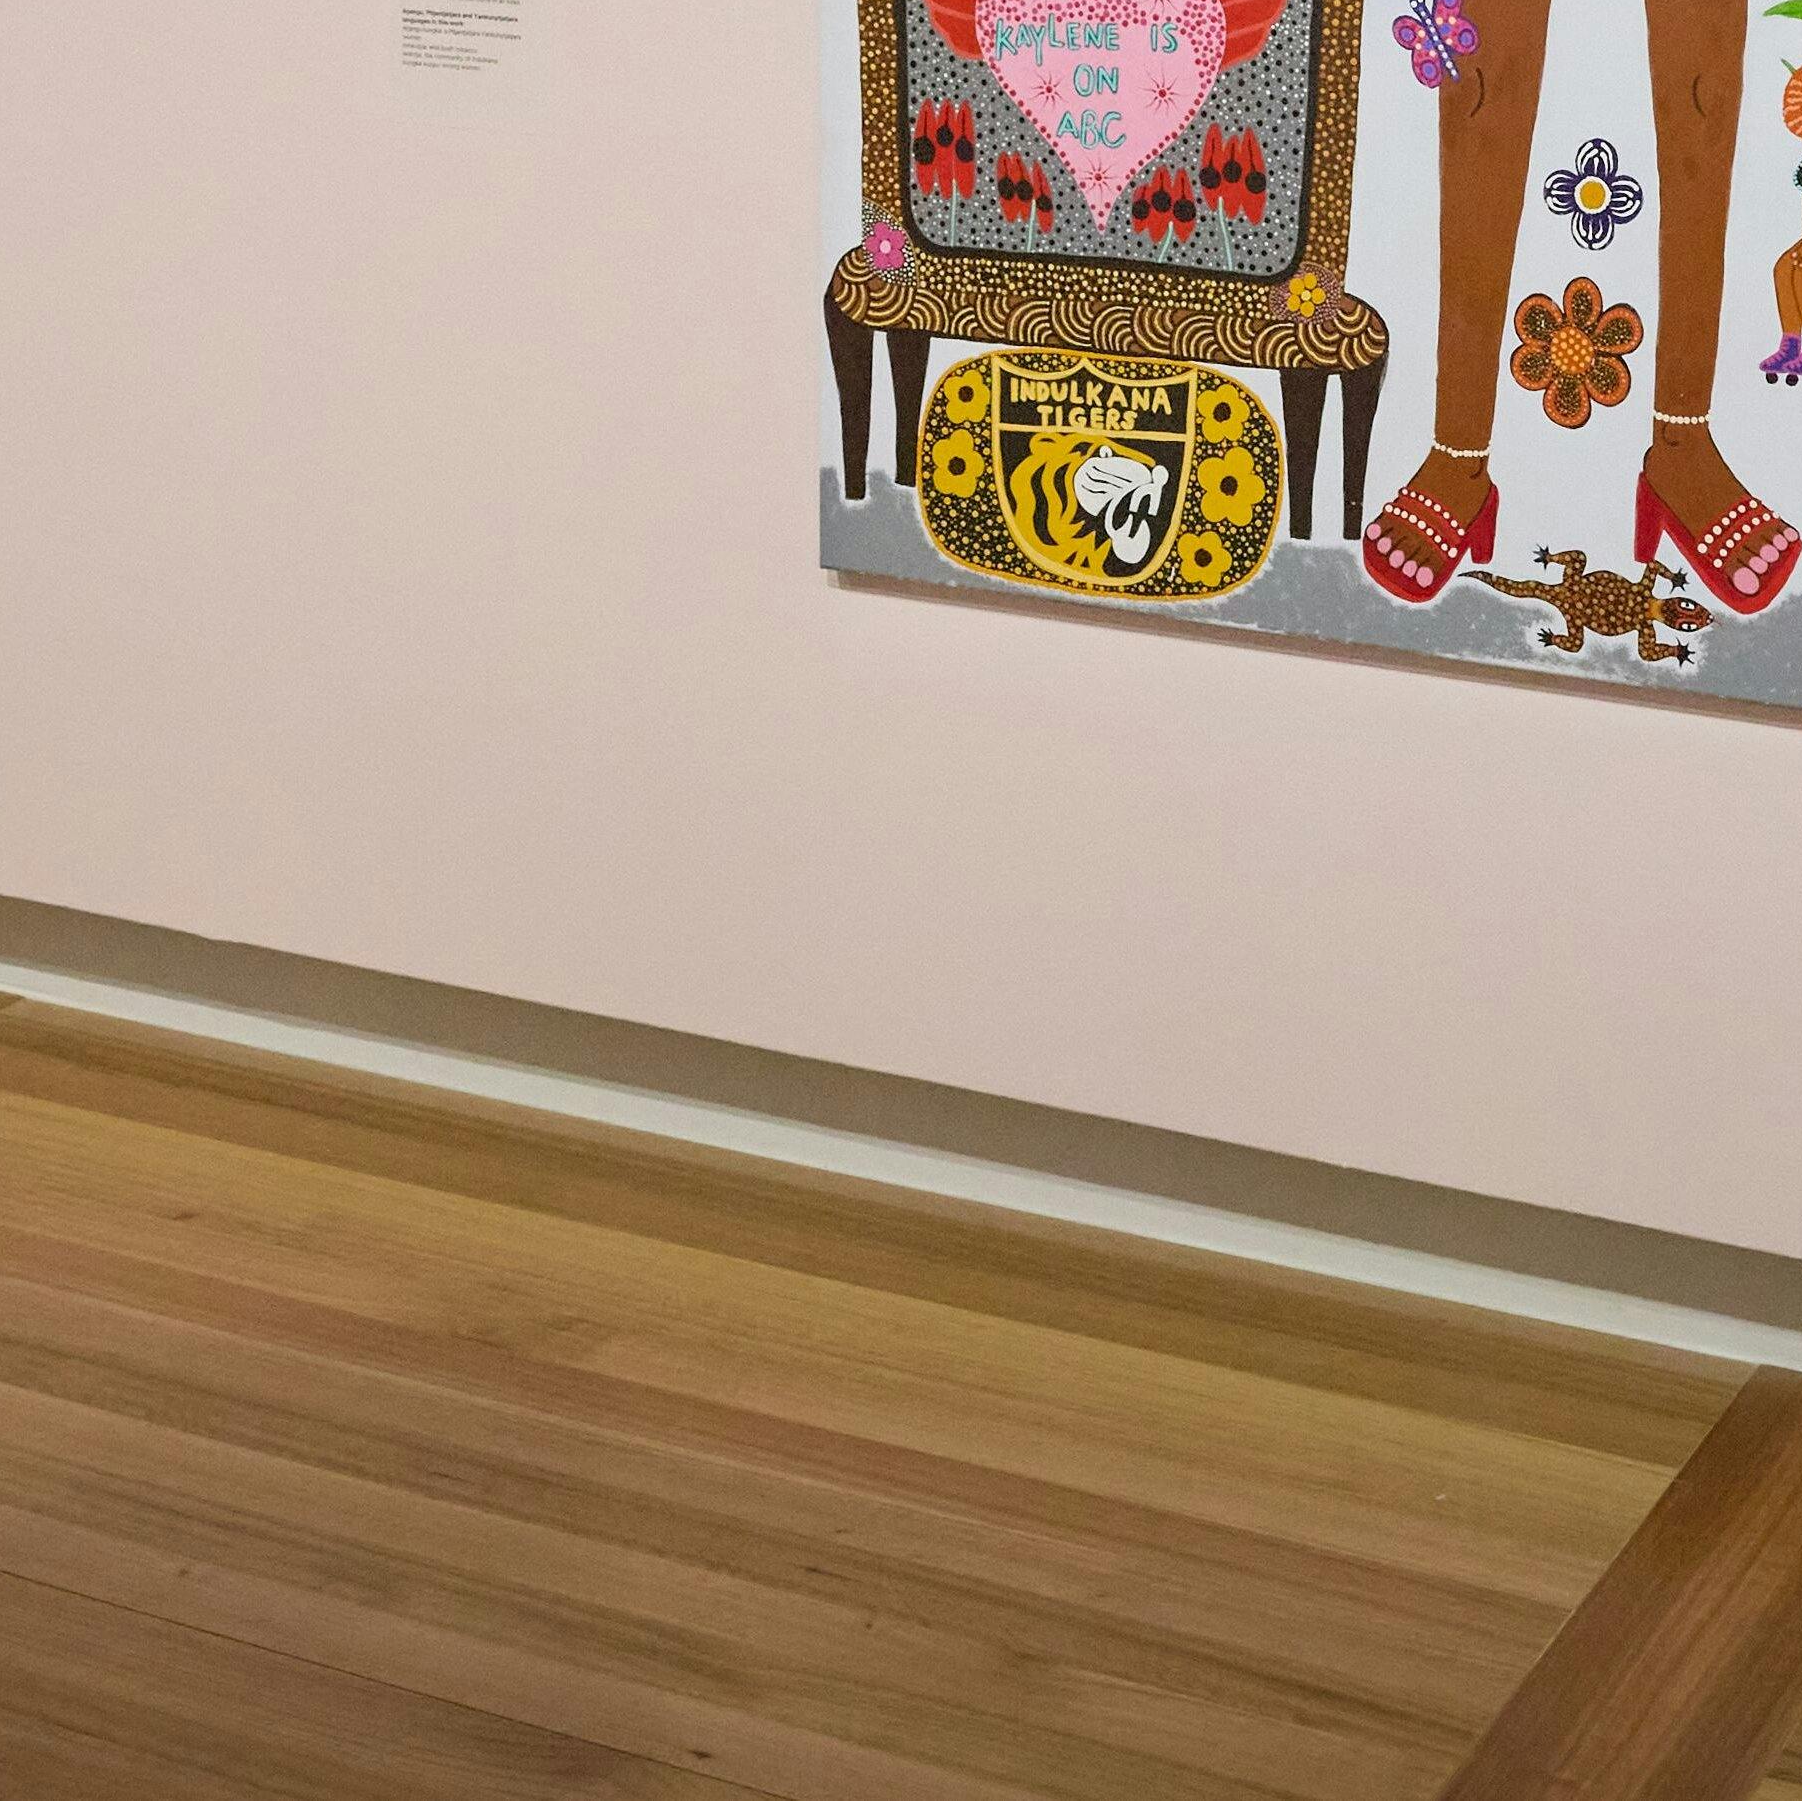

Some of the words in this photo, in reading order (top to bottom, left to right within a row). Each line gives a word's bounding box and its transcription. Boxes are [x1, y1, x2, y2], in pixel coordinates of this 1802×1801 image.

[994, 13, 1121, 66] KAYLENE
[1150, 23, 1178, 53] IS
[1073, 63, 1119, 97] ON
[1056, 110, 1127, 149] ABC
[1009, 377, 1173, 416] INDULKANA
[1036, 405, 1138, 431] TIGERS
